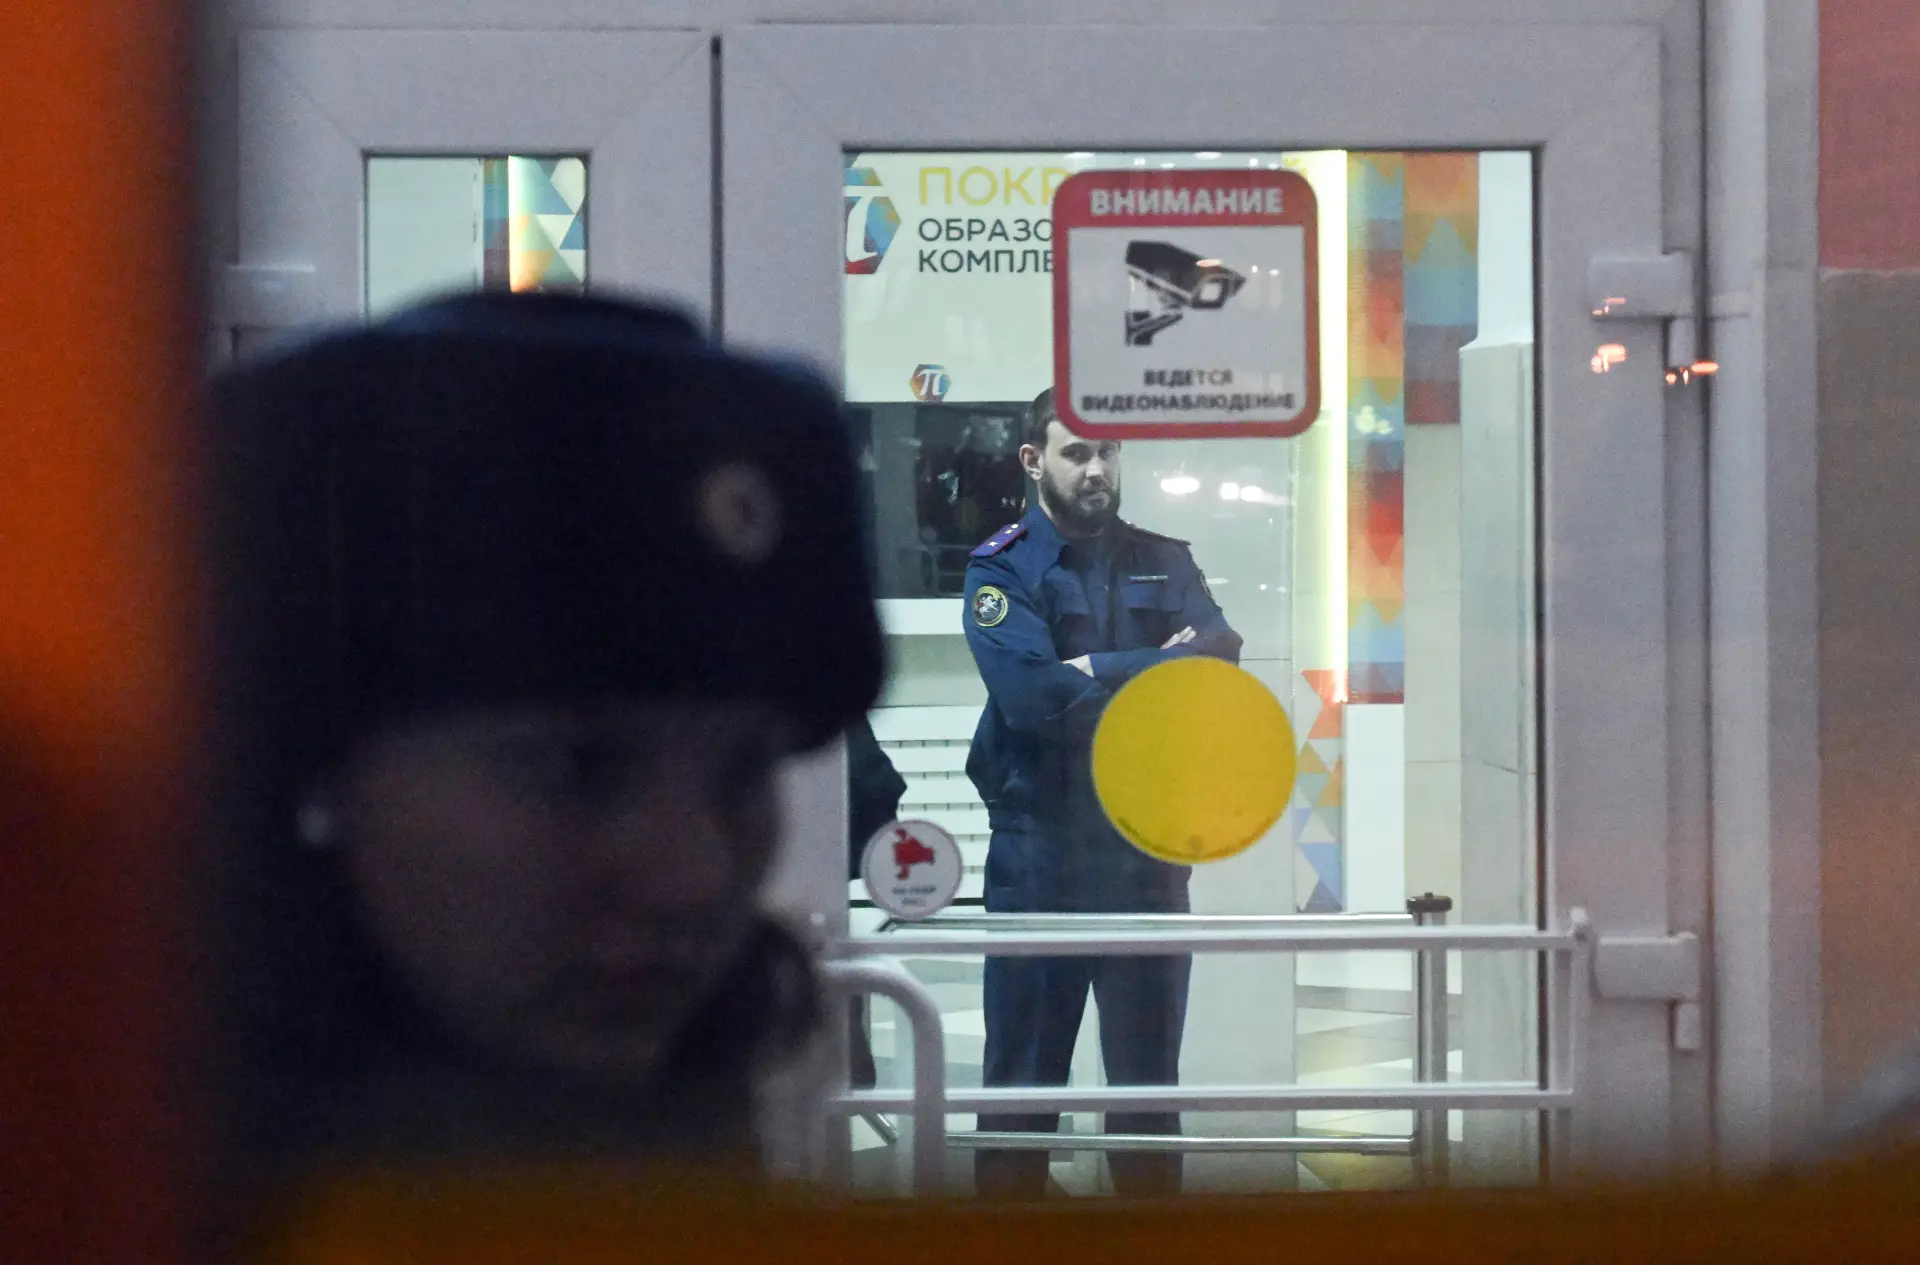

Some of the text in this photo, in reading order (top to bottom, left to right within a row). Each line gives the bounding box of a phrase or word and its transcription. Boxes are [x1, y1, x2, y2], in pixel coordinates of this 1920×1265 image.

[1090, 187, 1285, 216] ВНИМАНИЕ
[918, 218, 1053, 242] ОБРАЗО
[1143, 368, 1234, 387] ВЕДЕТСЯ
[1081, 391, 1297, 413] ВИДЕОНАБЛЮДЕНИЕ
